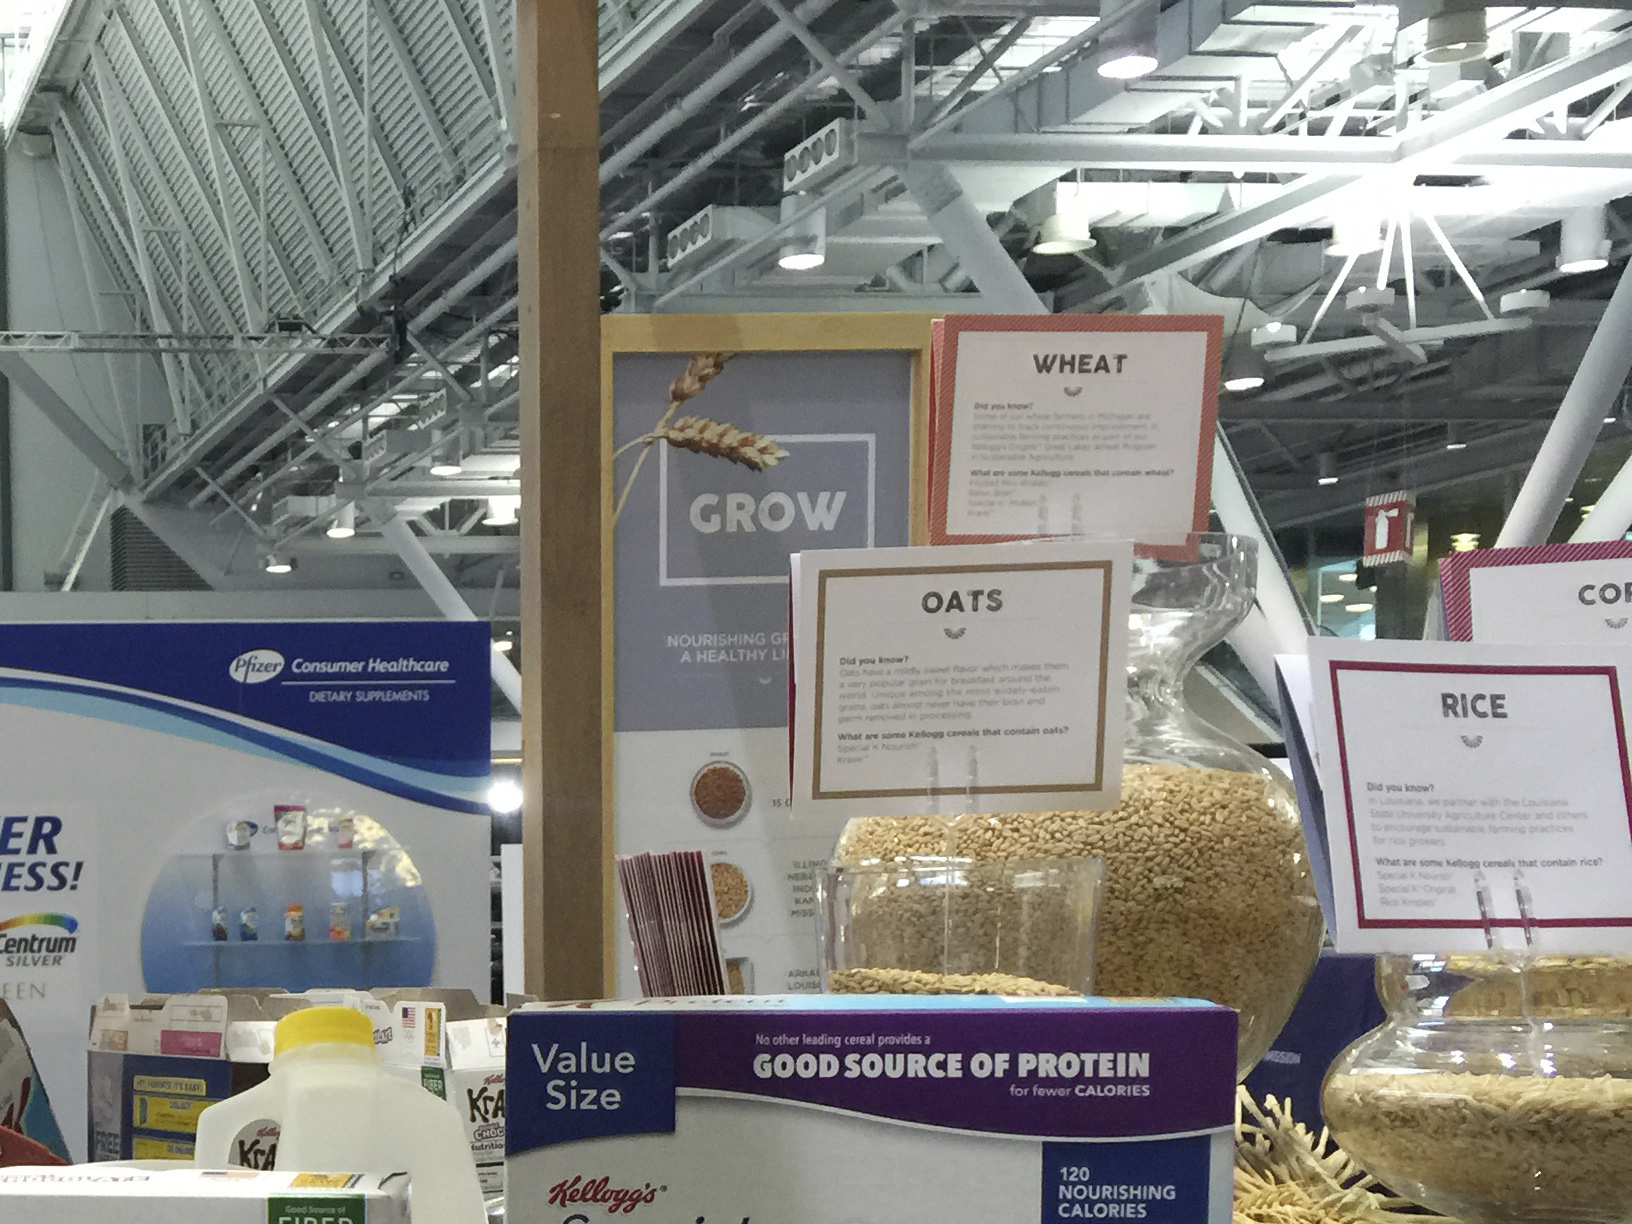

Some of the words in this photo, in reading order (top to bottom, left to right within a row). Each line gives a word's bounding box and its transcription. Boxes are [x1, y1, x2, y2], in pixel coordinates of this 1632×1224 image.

[1033, 354, 1128, 374] WHEAT
[689, 490, 847, 533] GROW
[921, 589, 1003, 614] OATS
[667, 633, 767, 648] NOURISHING
[681, 652, 692, 663] A
[697, 649, 767, 663] HEALTHY
[235, 655, 281, 683] Pfizer
[292, 658, 365, 673] Consumer
[368, 658, 449, 672] Healthcare
[310, 691, 352, 702] DIETARY
[356, 690, 429, 701] SUPPLEMENTS
[1441, 693, 1508, 719] RICE
[5, 955, 62, 966] SILVER
[755, 1034, 769, 1045] No
[772, 1034, 799, 1046] other
[802, 1033, 841, 1048] leading
[844, 1034, 875, 1046] cereal
[878, 1034, 922, 1048] provides
[924, 1036, 930, 1045] a
[531, 1041, 636, 1074] Value
[753, 1053, 839, 1078] GOOD
[844, 1053, 962, 1078] SOURCE
[970, 1053, 1009, 1078] OF
[1018, 1052, 1150, 1078] PROTEIN
[546, 1079, 622, 1110] Size
[1009, 1084, 1030, 1097] for
[1033, 1084, 1071, 1097] fewer
[1075, 1084, 1150, 1097] CALORIES
[1060, 1167, 1090, 1181] 120
[549, 1175, 657, 1213] Kellogg's
[1059, 1185, 1176, 1200] NOURISHING
[1058, 1203, 1147, 1218] CALORIES
